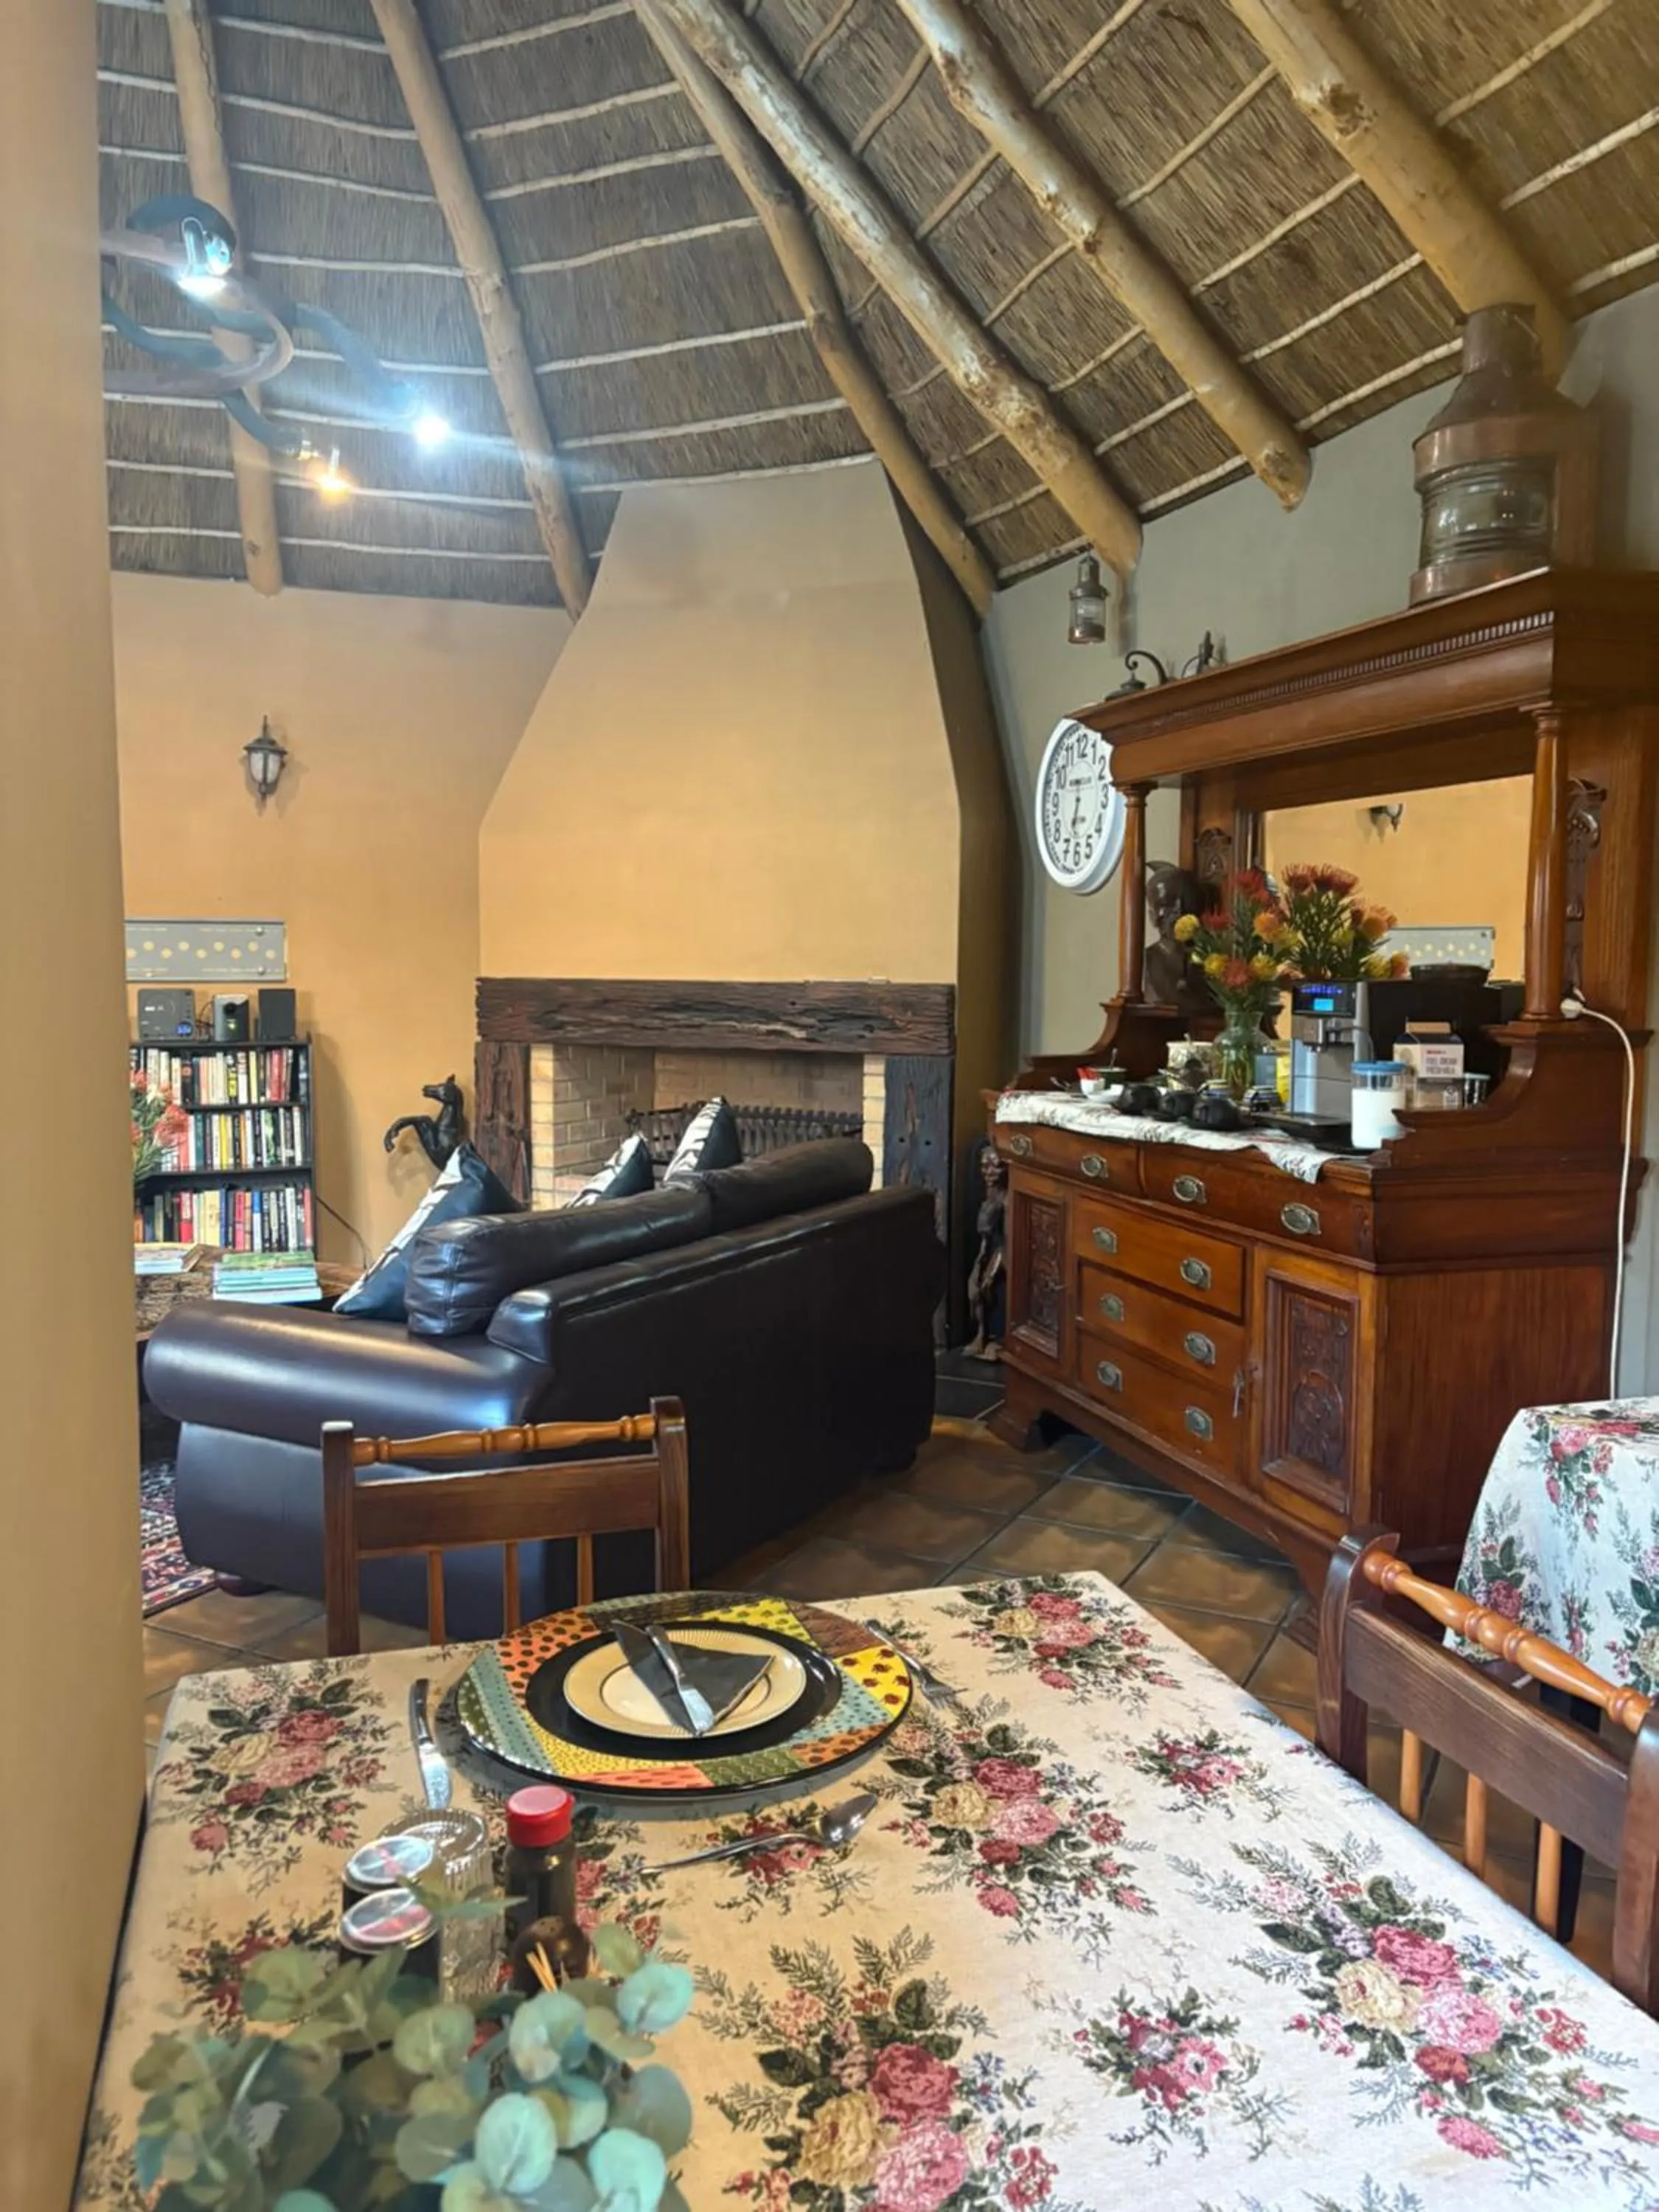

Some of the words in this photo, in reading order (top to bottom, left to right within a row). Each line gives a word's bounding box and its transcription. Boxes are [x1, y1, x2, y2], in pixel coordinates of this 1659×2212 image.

[1065, 742, 1074, 766] 11
[1077, 734, 1088, 758] 12
[1091, 740, 1096, 765] 1
[1055, 765, 1066, 790] 10
[1098, 757, 1107, 781] 2
[1051, 793, 1059, 816] 9
[1101, 783, 1109, 809] 3
[1054, 819, 1061, 843] 8
[1095, 813, 1102, 838] 4
[1063, 839, 1070, 862] 7
[1073, 842, 1080, 866] 6
[1085, 835, 1093, 859] 5
